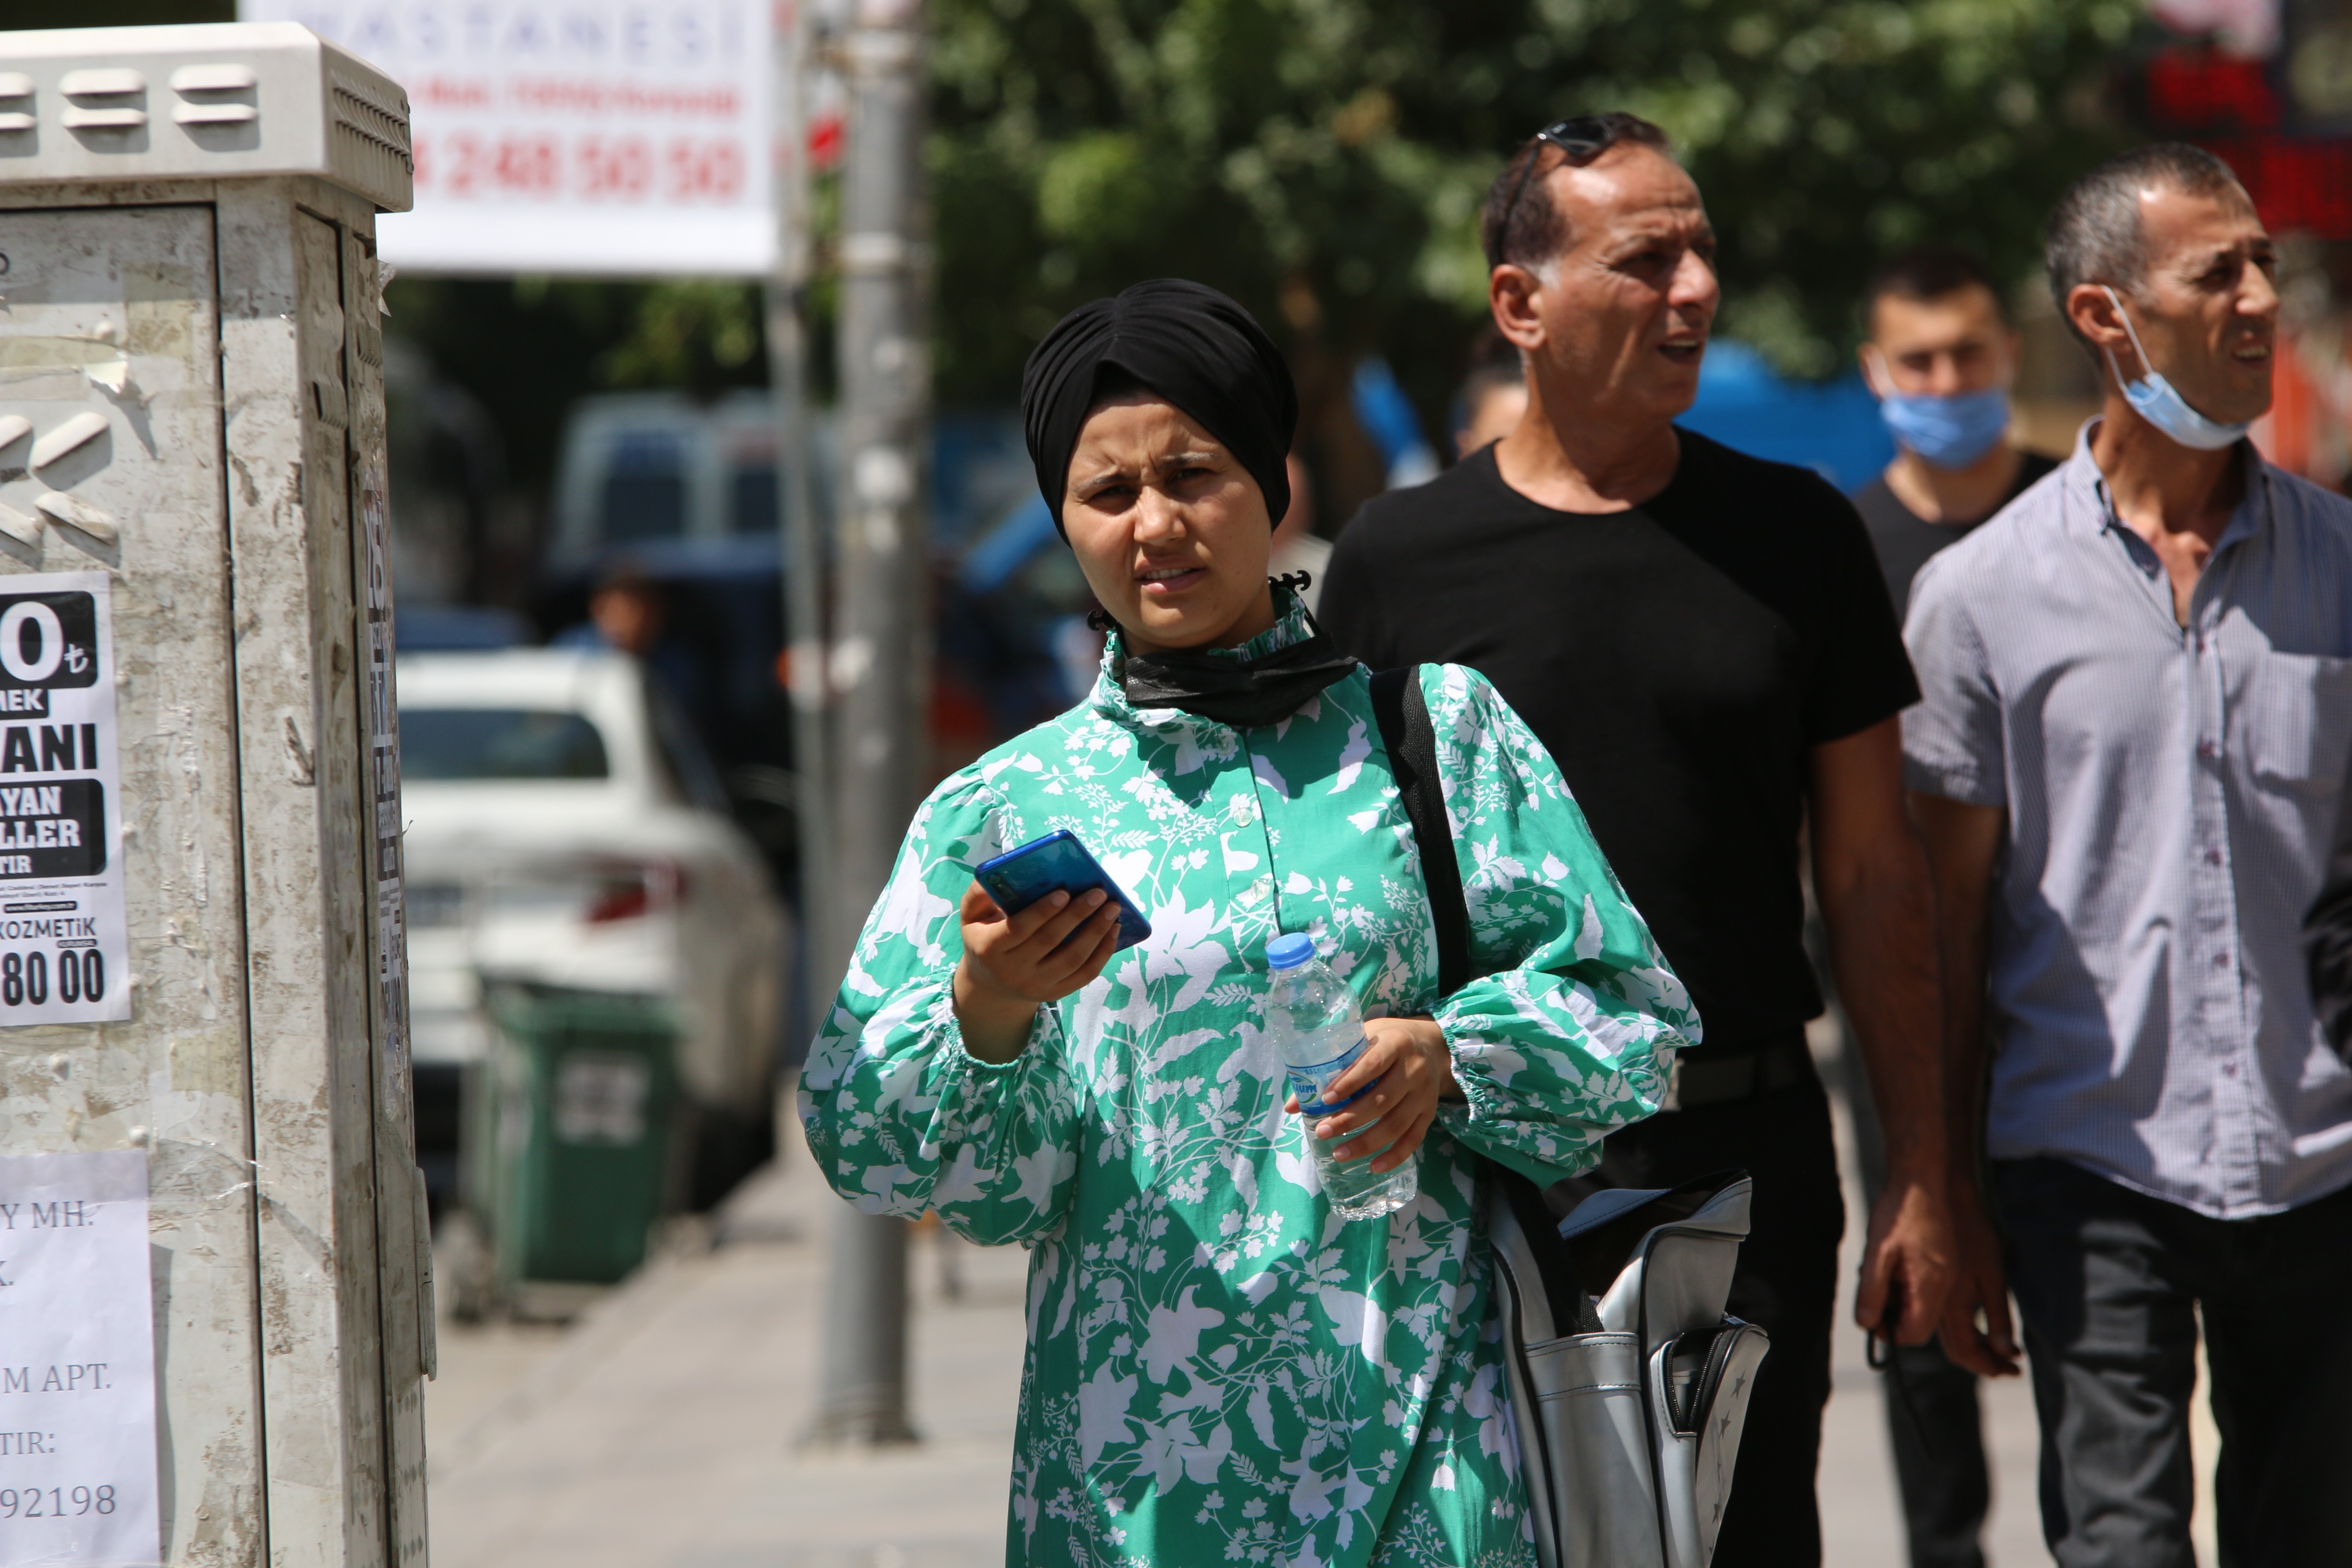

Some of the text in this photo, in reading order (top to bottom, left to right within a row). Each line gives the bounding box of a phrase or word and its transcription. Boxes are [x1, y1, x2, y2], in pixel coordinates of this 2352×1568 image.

[0, 786, 62, 817] YAN
[3, 949, 104, 1006] 80 00
[31, 1200, 94, 1228] MH.
[40, 1363, 111, 1392] APT.
[0, 1485, 116, 1519] 92198
